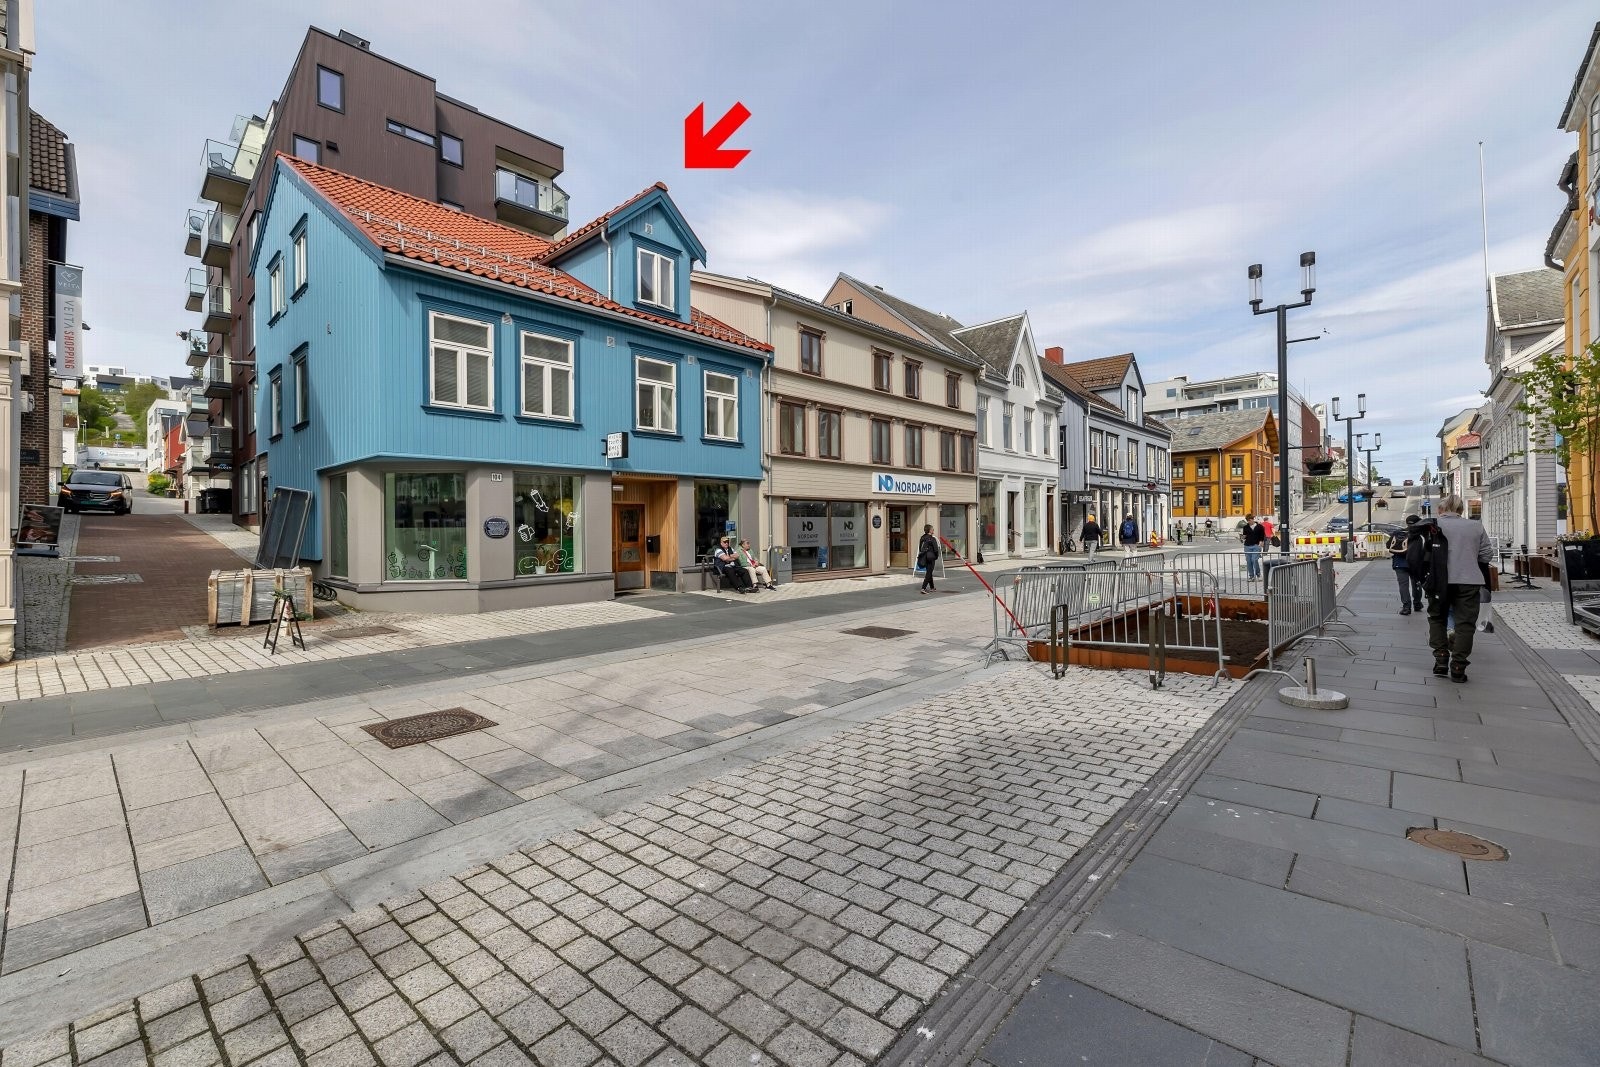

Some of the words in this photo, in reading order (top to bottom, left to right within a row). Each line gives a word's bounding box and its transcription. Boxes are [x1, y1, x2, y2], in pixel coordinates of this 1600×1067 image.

[58, 281, 80, 289] VEITA
[64, 300, 75, 329] VEITA
[64, 330, 75, 369] SHOPPING
[895, 481, 932, 494] NORDAMP
